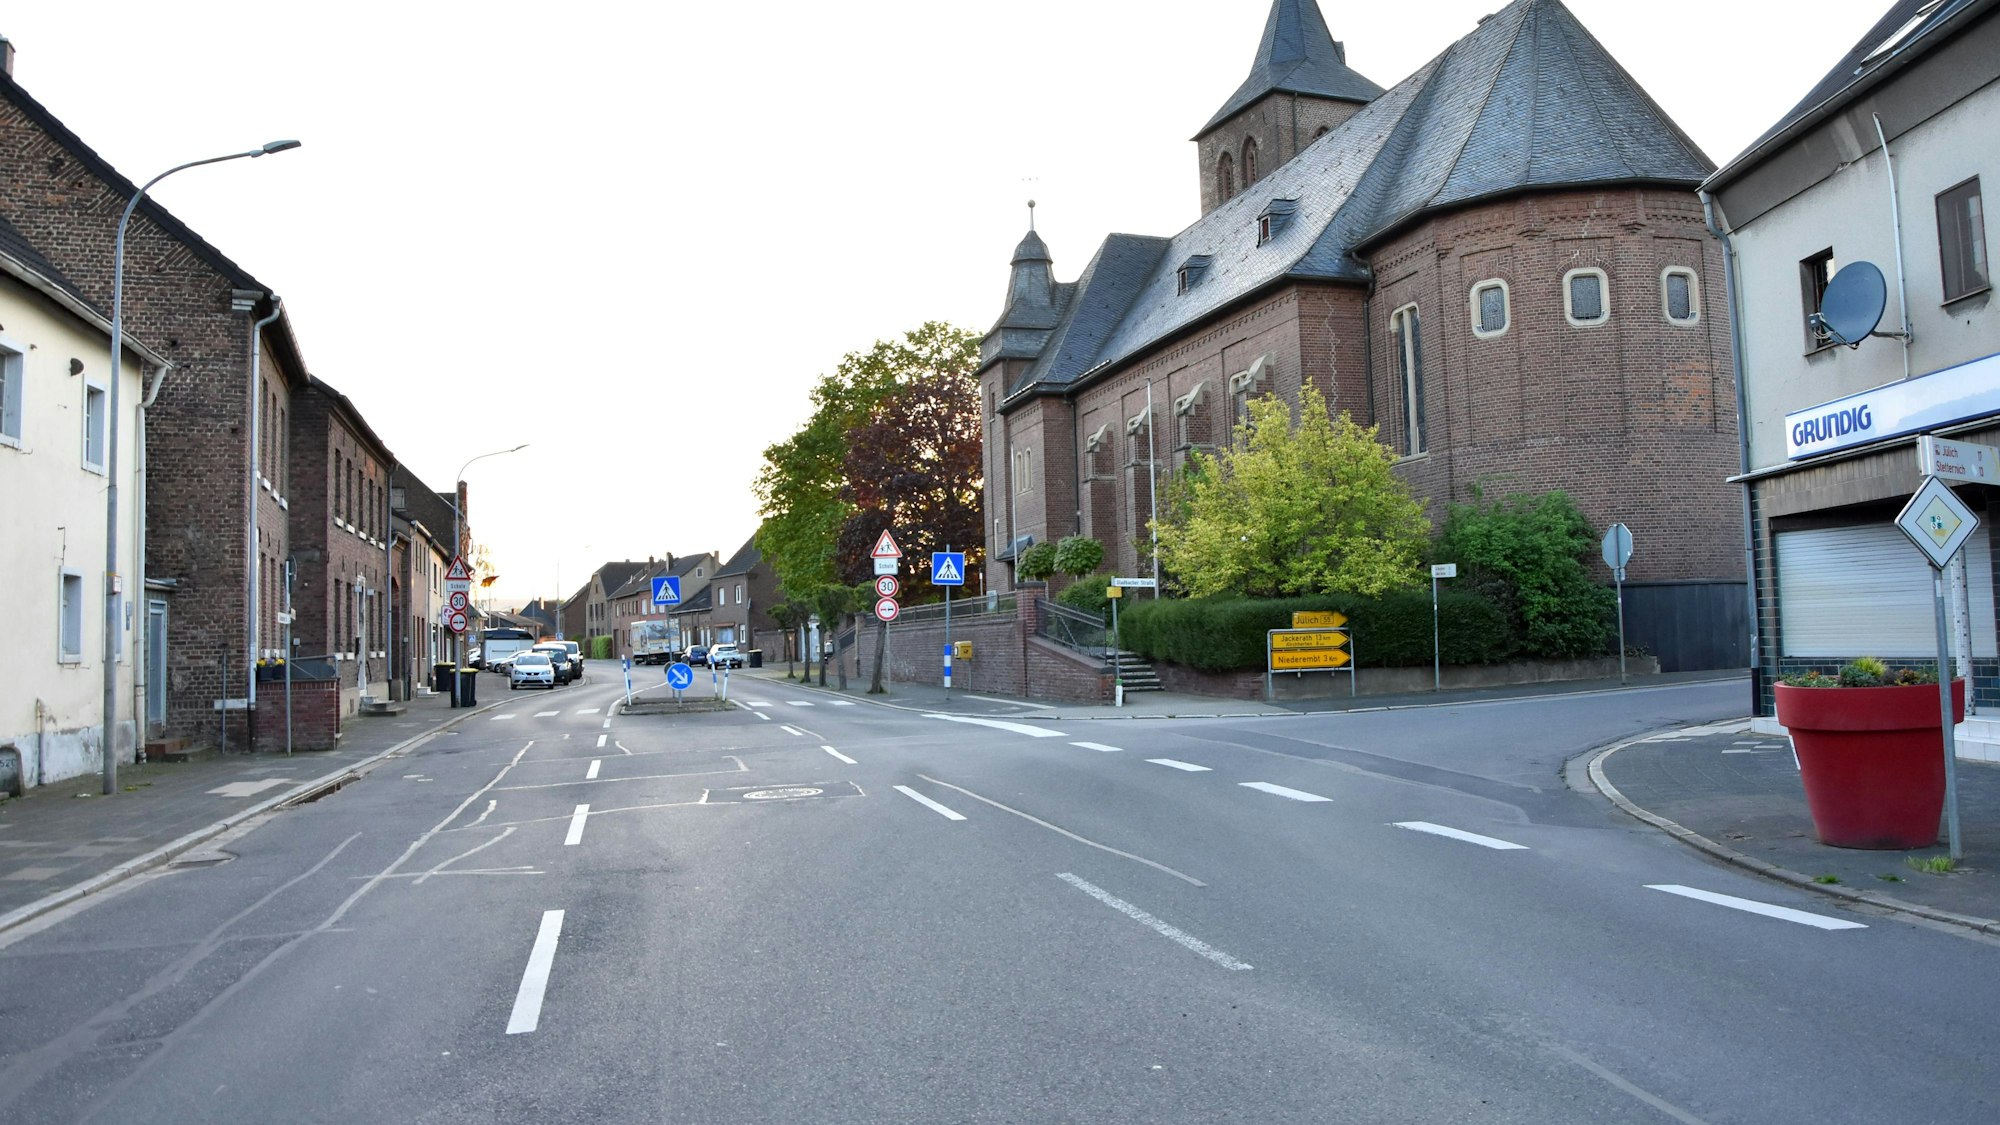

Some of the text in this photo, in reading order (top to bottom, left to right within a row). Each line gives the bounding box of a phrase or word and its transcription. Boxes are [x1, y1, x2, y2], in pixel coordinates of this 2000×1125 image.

[1792, 404, 1872, 447] GRUNDIG
[1942, 445, 1959, 457] Jülich
[1936, 460, 1966, 474] Stetternich
[880, 581, 894, 592] 30
[453, 596, 464, 607] 30
[1296, 616, 1318, 625] Jülich
[1278, 656, 1321, 664] Niederembt
